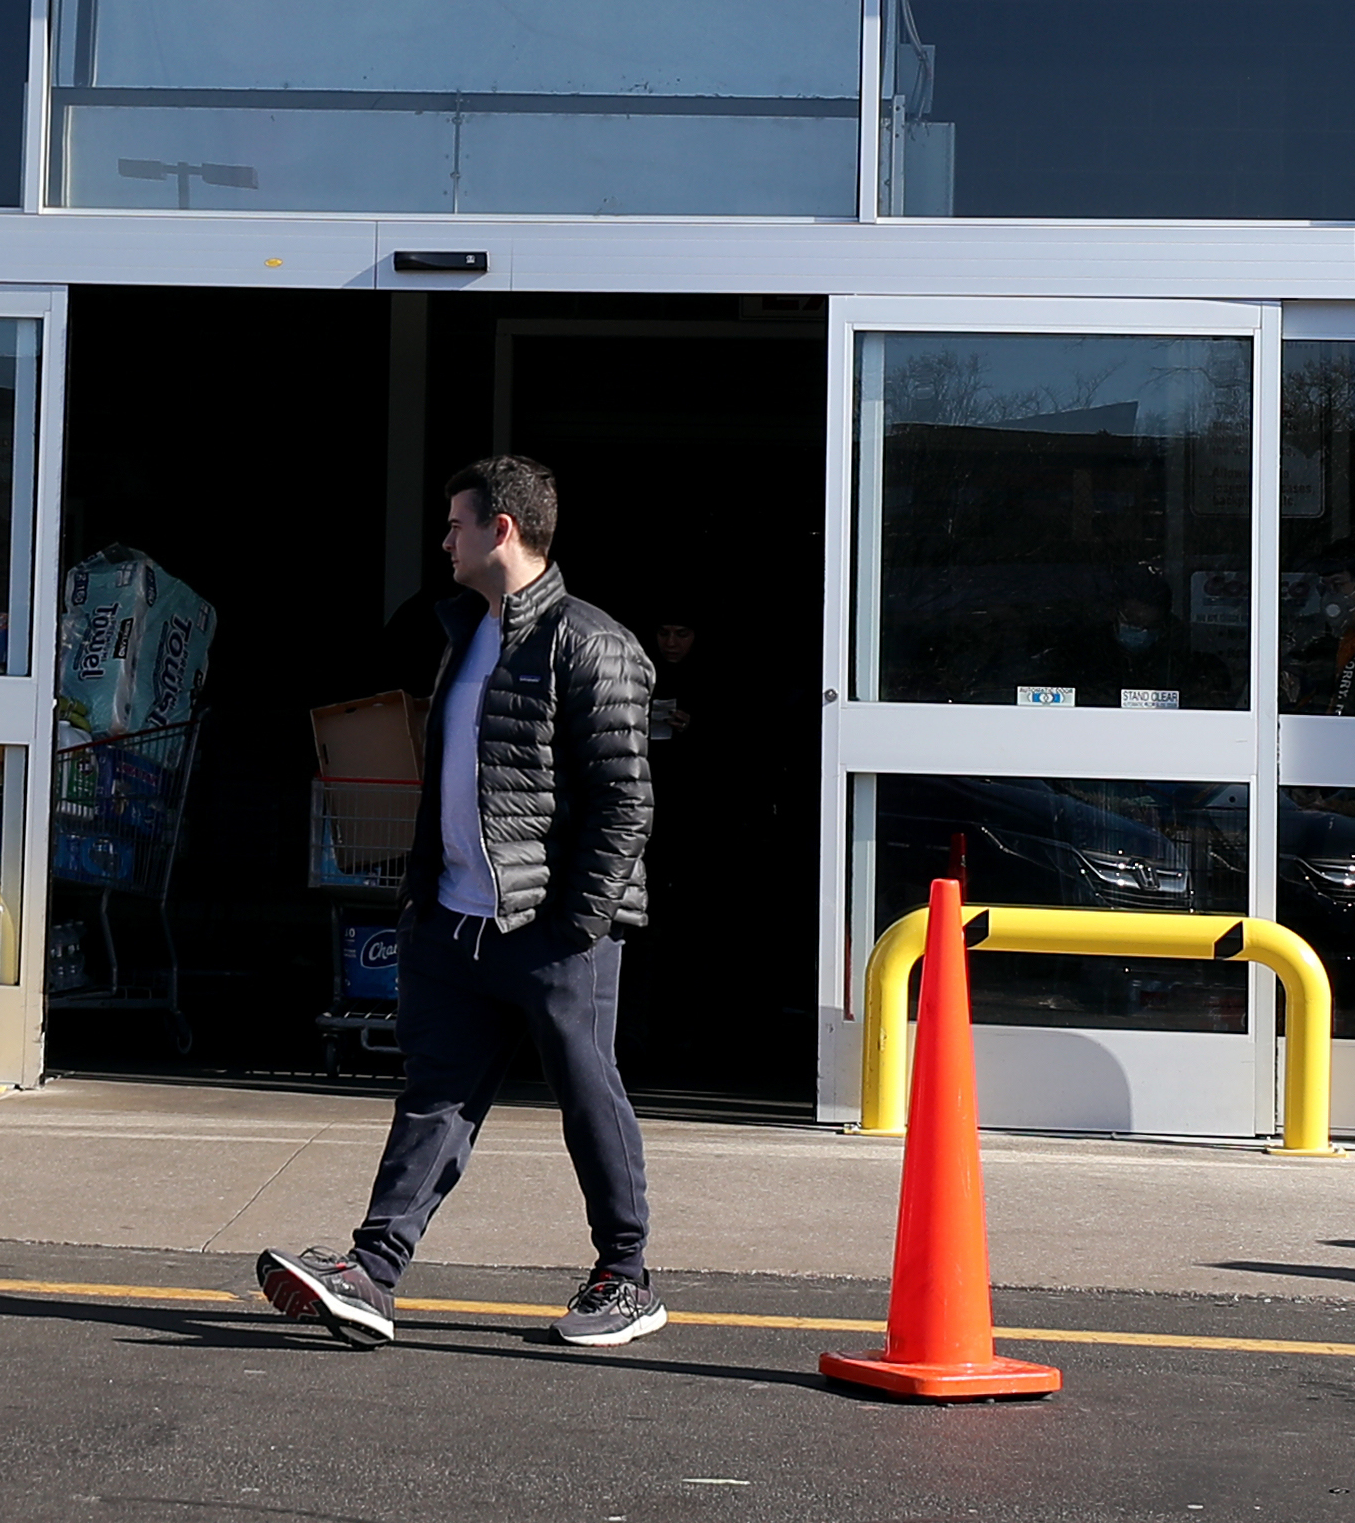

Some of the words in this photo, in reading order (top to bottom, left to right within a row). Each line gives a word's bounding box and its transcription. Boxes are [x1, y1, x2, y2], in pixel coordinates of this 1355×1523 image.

[82, 603, 119, 680] Towel
[1123, 691, 1149, 701] STAND
[1151, 691, 1178, 702] CLEAR
